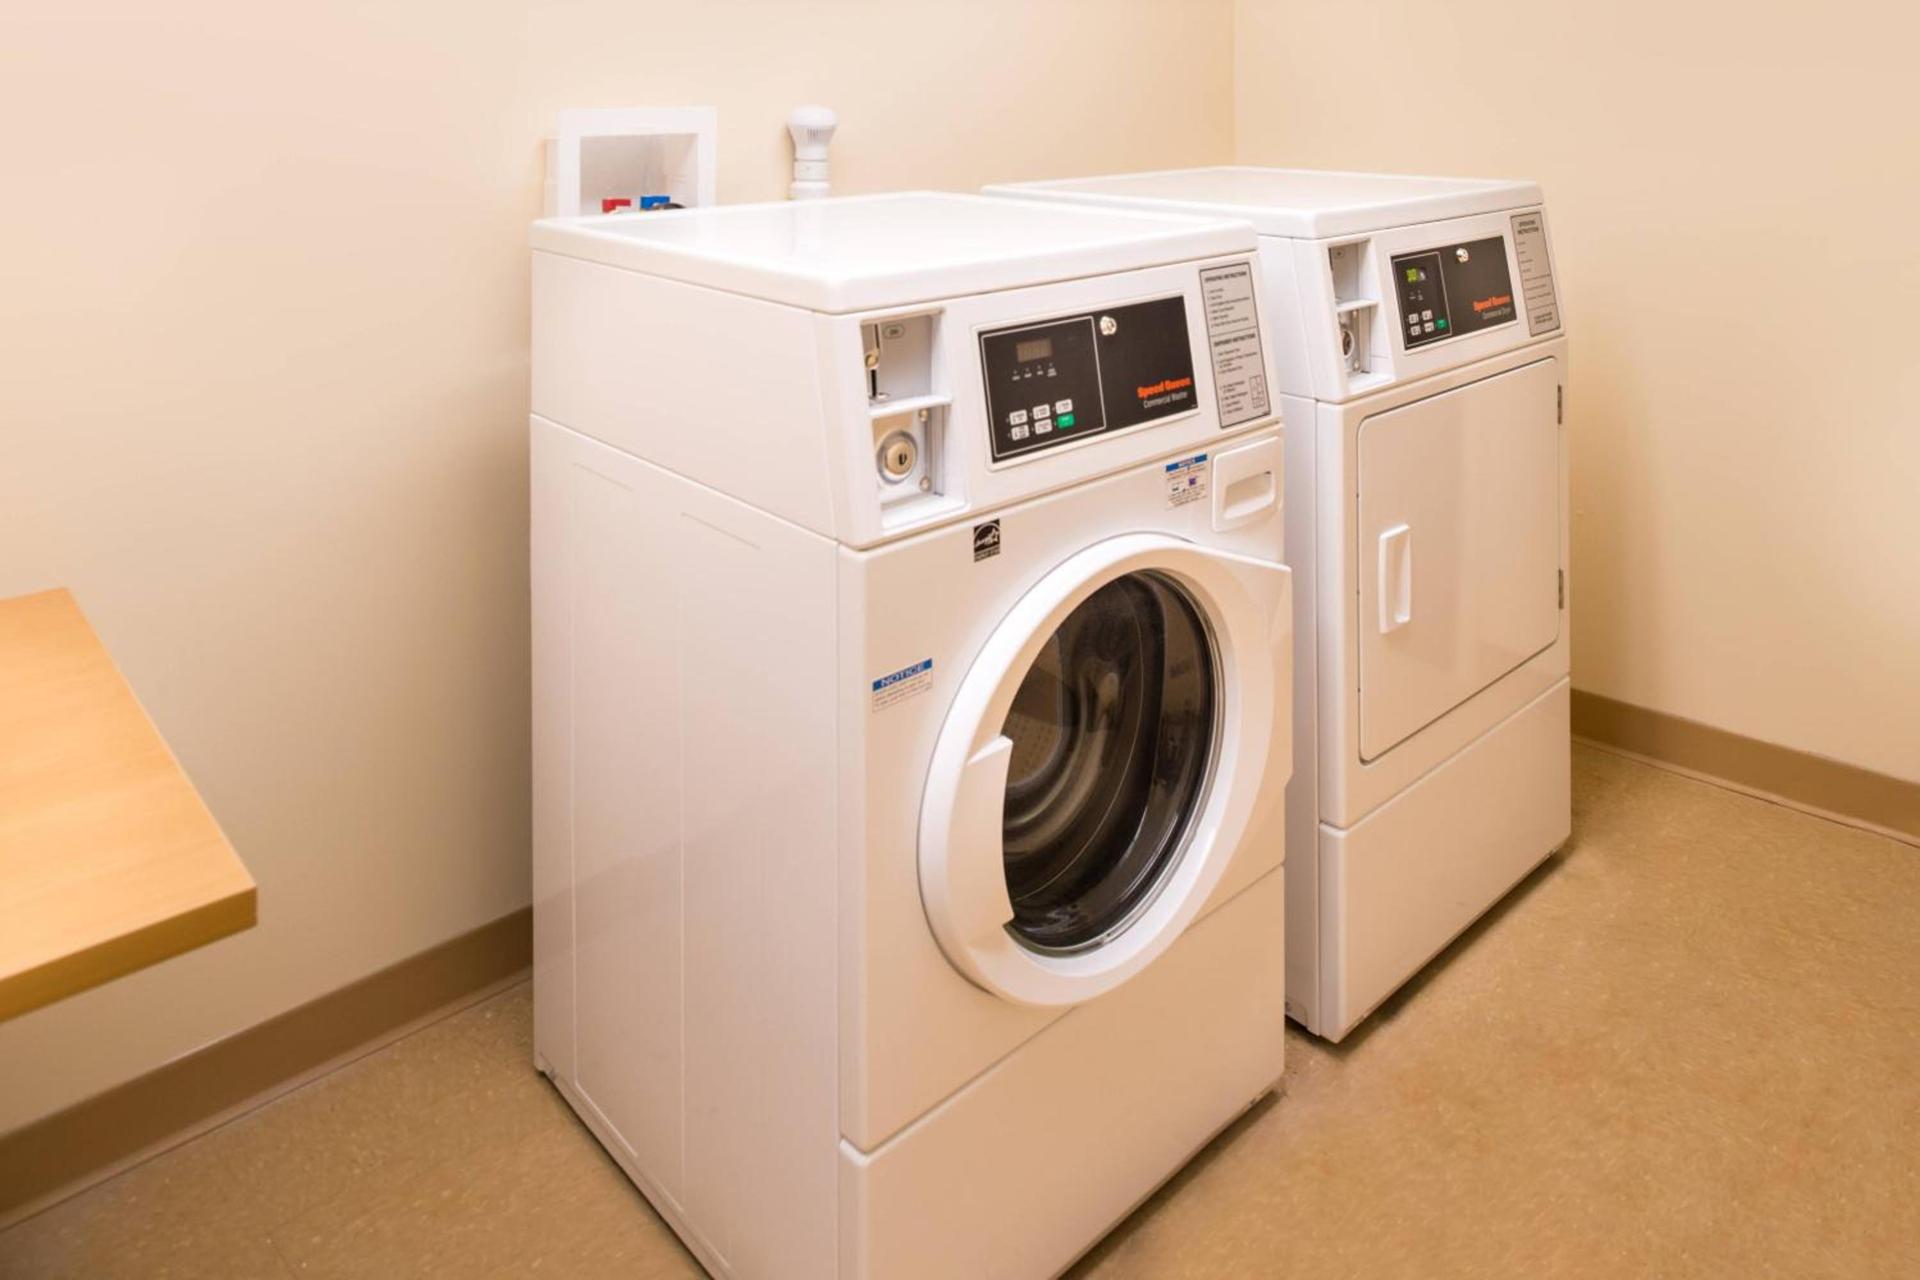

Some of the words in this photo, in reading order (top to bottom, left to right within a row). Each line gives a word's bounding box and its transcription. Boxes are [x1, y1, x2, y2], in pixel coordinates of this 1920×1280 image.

[1473, 299, 1491, 312] Speed
[1137, 381, 1164, 399] Speed
[1164, 377, 1191, 391] Queen
[1143, 394, 1170, 408] Commercial
[880, 664, 922, 688] NOTICE
